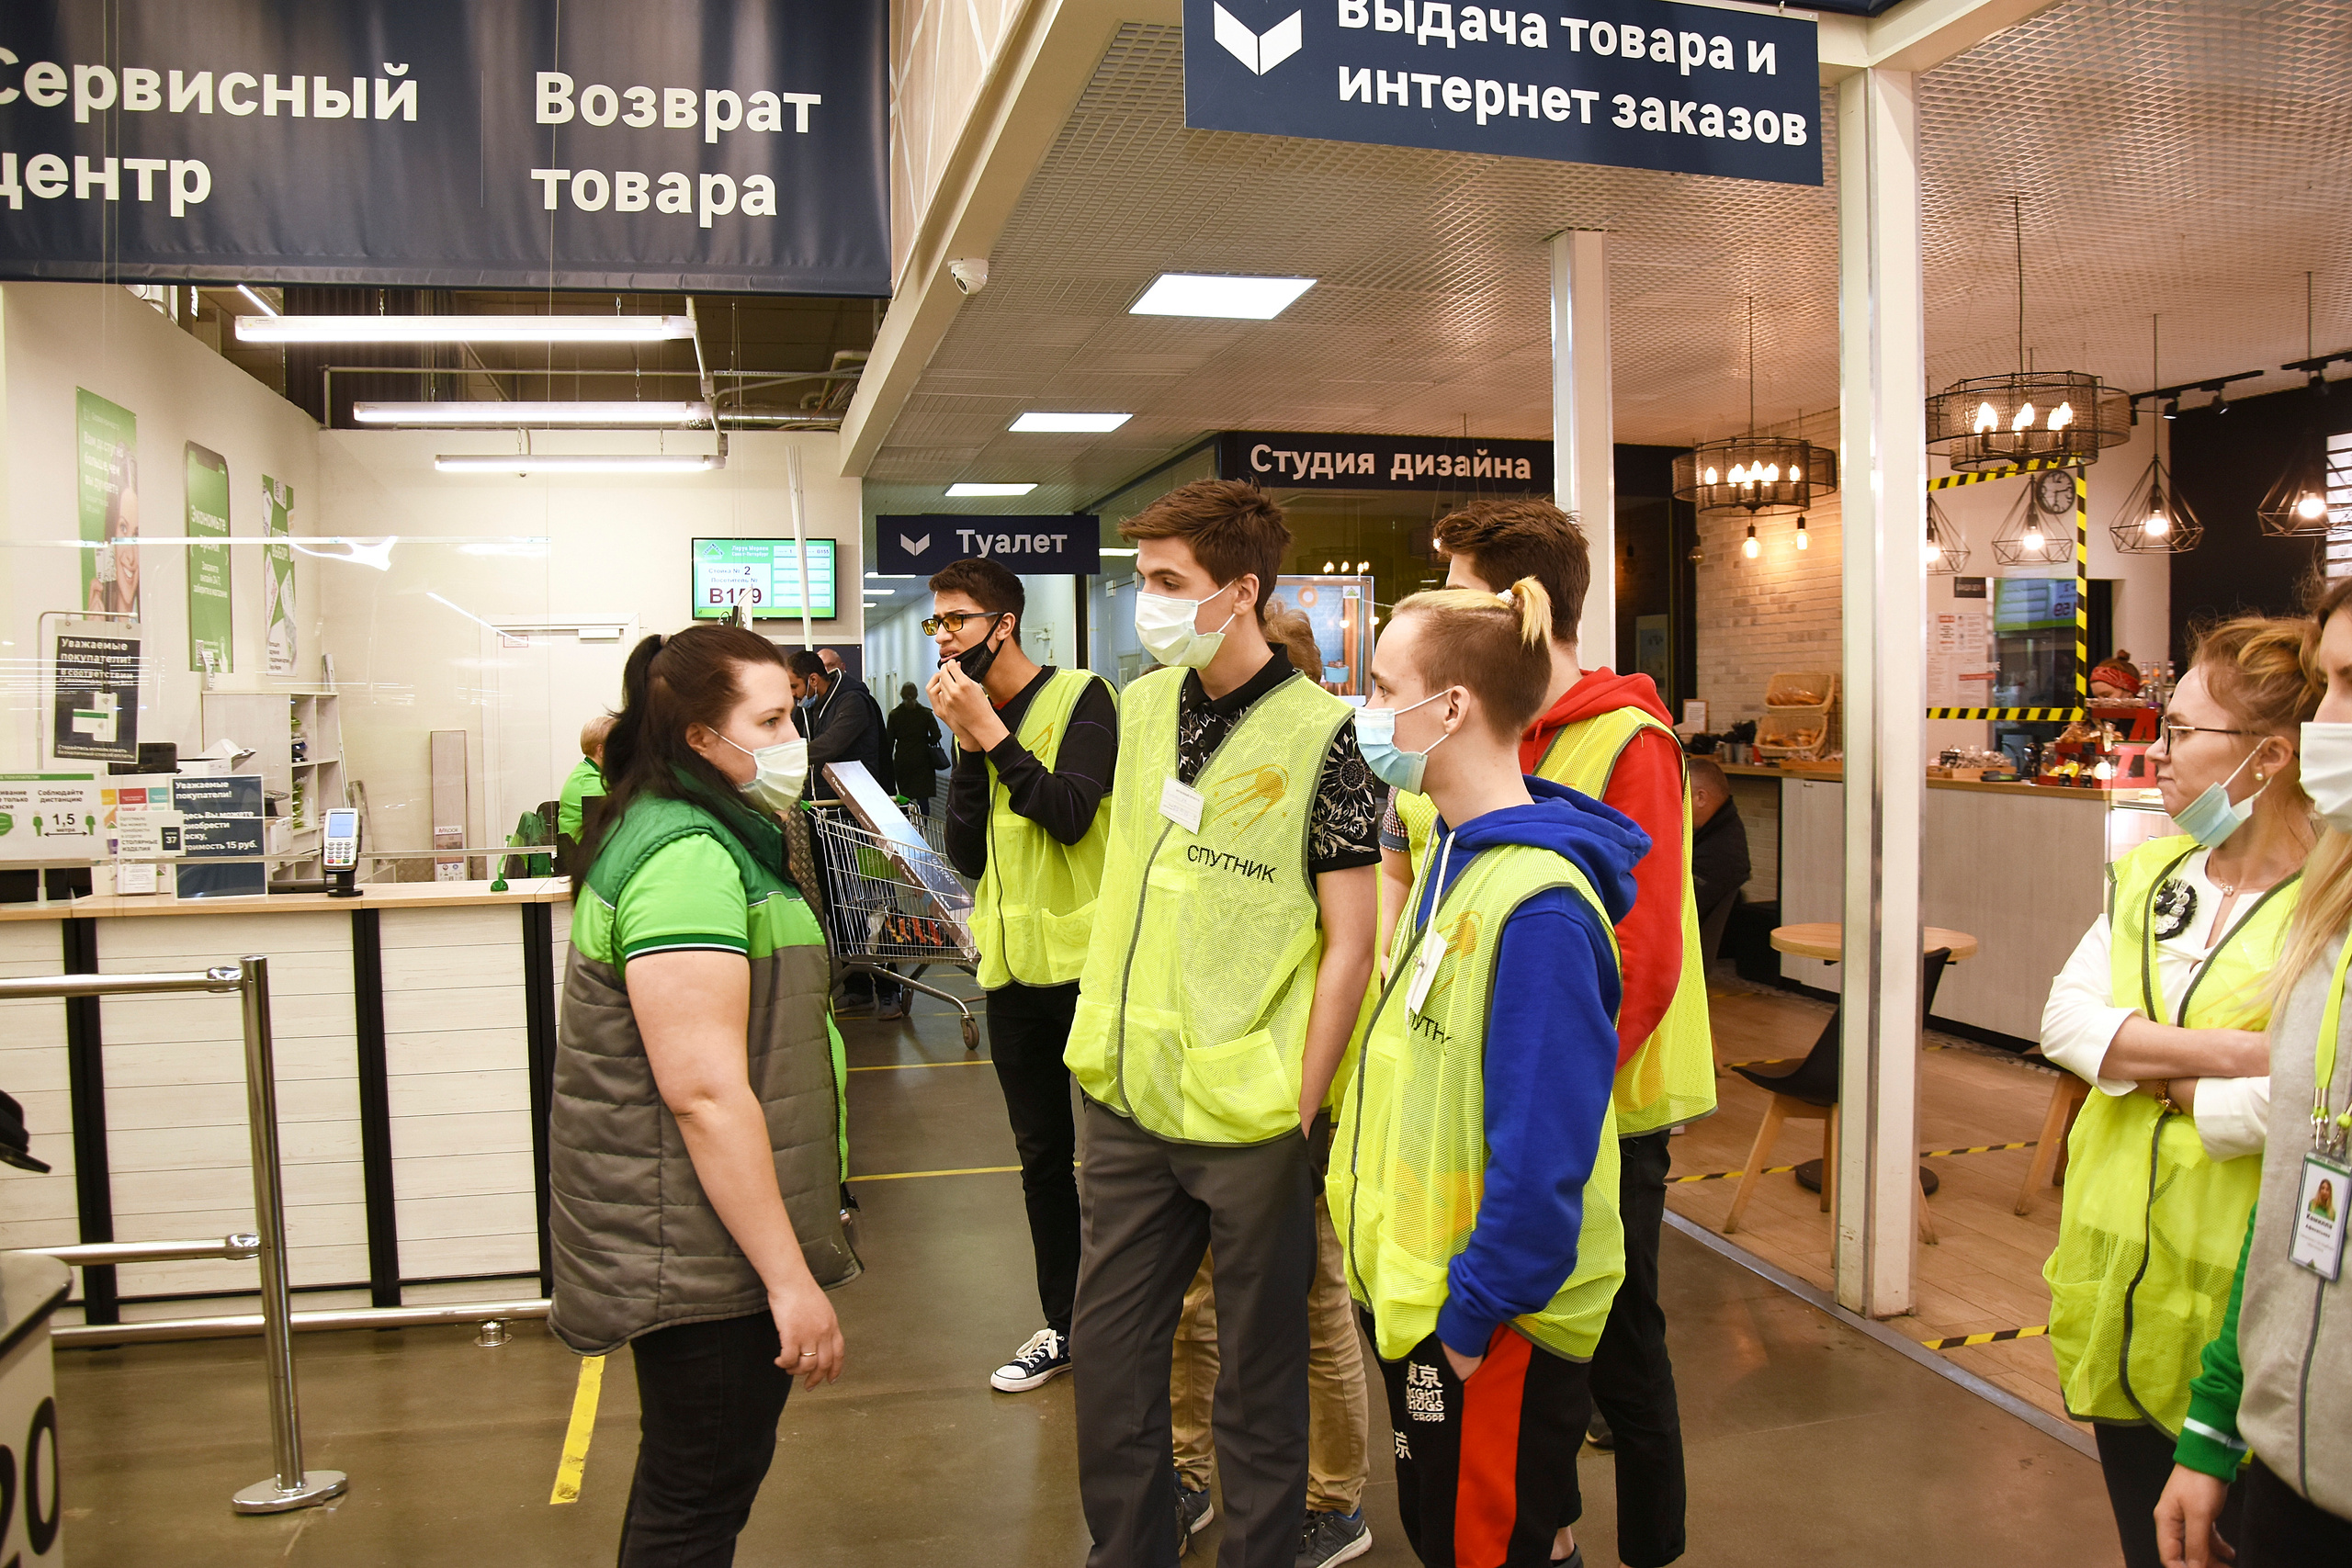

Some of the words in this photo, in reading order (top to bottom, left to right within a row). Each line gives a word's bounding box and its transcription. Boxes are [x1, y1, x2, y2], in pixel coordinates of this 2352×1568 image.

[1338, 0, 1548, 49] Выдача
[1561, 17, 1735, 75] товара
[1747, 40, 1777, 75] и
[536, 71, 821, 143] Возврат
[1339, 65, 1600, 126] интернет
[1611, 94, 1807, 146] заказов
[531, 169, 777, 228] товара
[1250, 444, 1375, 480] Студия
[1391, 447, 1532, 481] дизайна
[191, 504, 226, 532] Экономьте
[956, 529, 1068, 560] Туалет
[744, 566, 751, 575] 2
[709, 588, 762, 604] B19
[61, 638, 129, 650] Уважаемые
[60, 653, 131, 663] покупатели!
[38, 789, 84, 798] Соблюдайте
[175, 791, 232, 800] покупатели!
[52, 813, 75, 827] 1,5
[184, 822, 230, 830] риобрести
[226, 840, 236, 849] 15
[238, 840, 257, 850] руб.
[1187, 844, 1277, 884] СПУТНИК
[1412, 1413, 1445, 1422] CROPP
